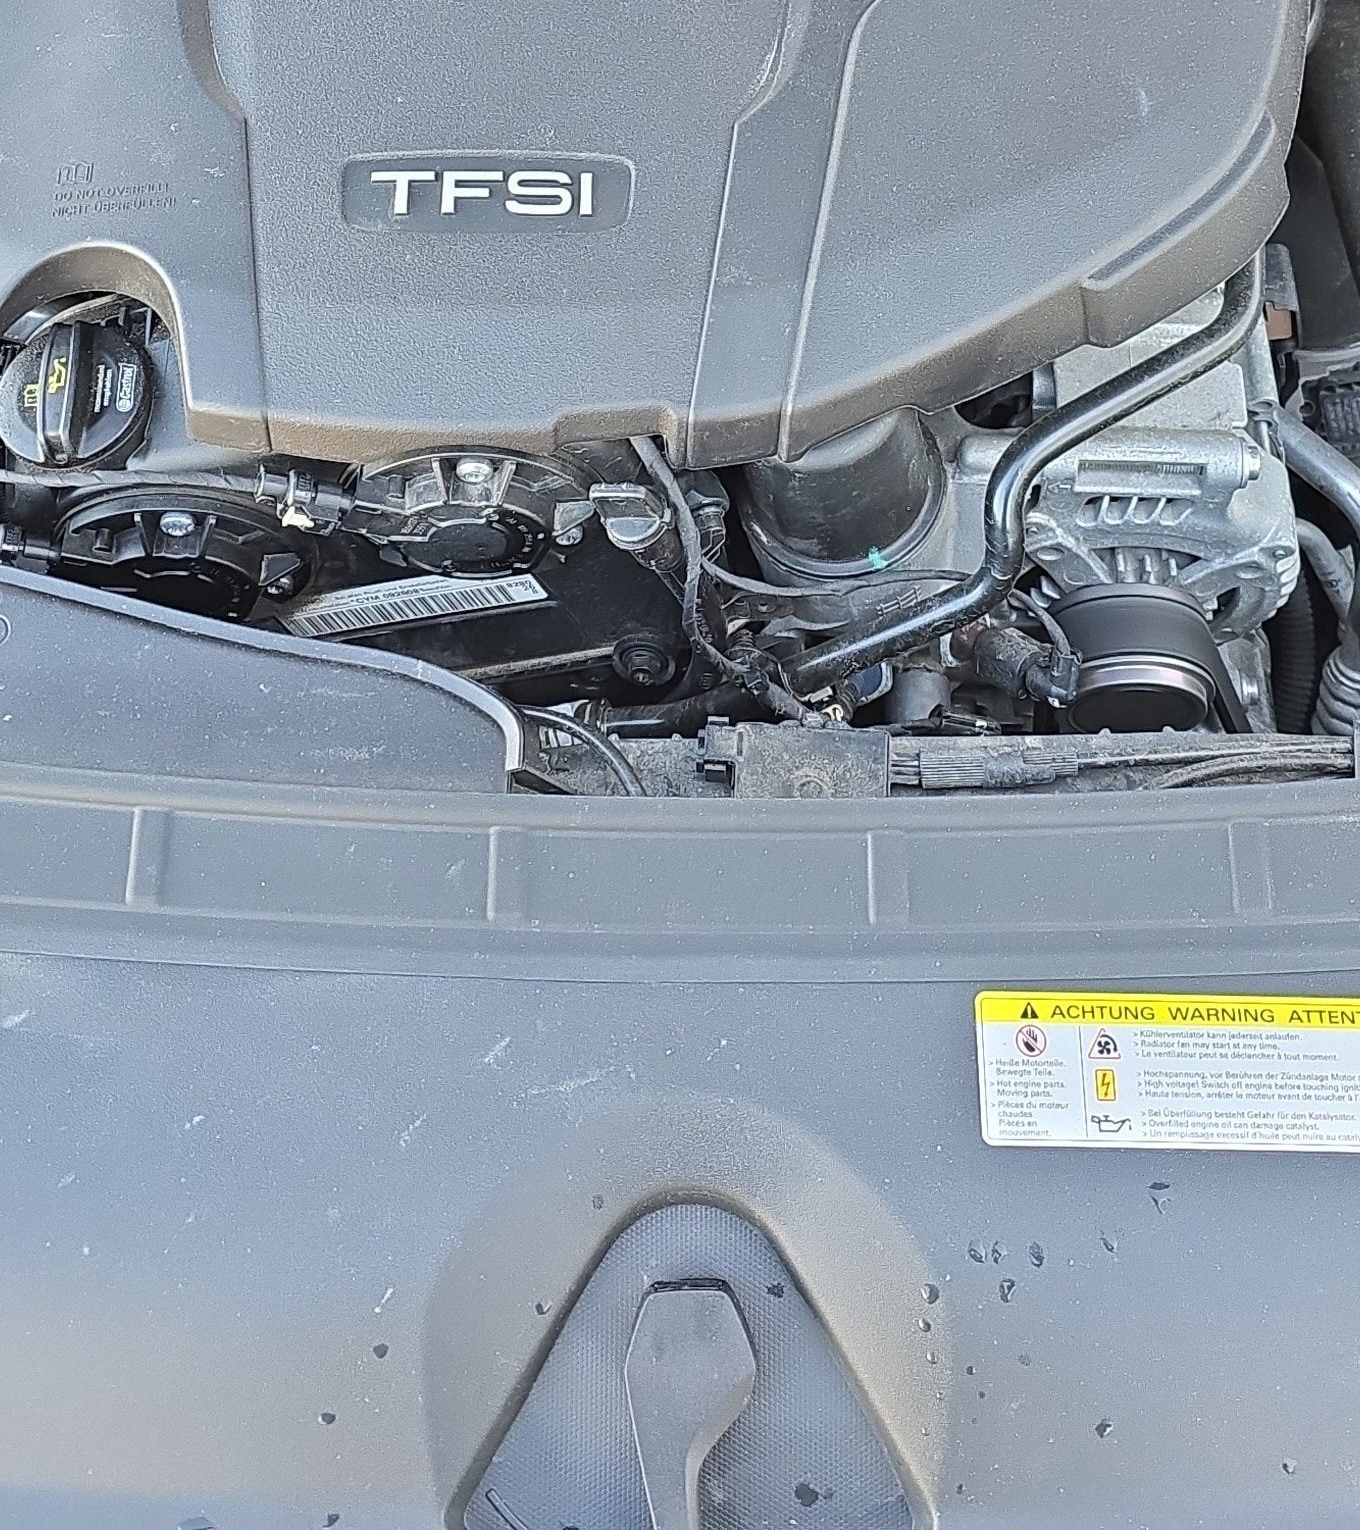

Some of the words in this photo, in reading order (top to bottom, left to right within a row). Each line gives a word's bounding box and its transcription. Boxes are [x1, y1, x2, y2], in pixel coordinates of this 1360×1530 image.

[54, 191, 73, 202] DO
[76, 187, 103, 200] NOT
[371, 170, 595, 216] TFSI
[120, 367, 133, 399] Castrol
[1050, 1004, 1155, 1021] ACHTUNG
[1167, 1007, 1275, 1023] WARNING
[1206, 1031, 1226, 1039] kann
[1140, 1040, 1175, 1048] Radiator
[1177, 1040, 1190, 1048] fan
[1192, 1042, 1209, 1050] may
[1242, 1043, 1257, 1051] any
[1153, 1050, 1197, 1058] ventilateur
[1199, 1051, 1218, 1061] peut
[1283, 1053, 1300, 1061] tout
[996, 1067, 1031, 1077] Bewegte
[1265, 1072, 1279, 1080] der
[1331, 1073, 1356, 1081] Motor
[1013, 1080, 1042, 1089] engine
[1043, 1081, 1067, 1089] parts.
[1144, 1080, 1163, 1089] High
[1201, 1080, 1229, 1089] Switch
[1231, 1081, 1243, 1089] off
[1244, 1081, 1273, 1091] engine
[1274, 1082, 1301, 1090] before
[1303, 1083, 1339, 1093] touching
[996, 1089, 1028, 1098] Moving
[1245, 1091, 1275, 1100] moteur
[1301, 1093, 1312, 1101] de
[1314, 1093, 1345, 1101] toucher
[1026, 1101, 1037, 1109] du
[1147, 1109, 1161, 1117] Bei
[1214, 1110, 1245, 1119] besteht
[1246, 1111, 1275, 1119] Gefahr
[1277, 1111, 1289, 1120] für
[1291, 1111, 1307, 1120] den
[1191, 1120, 1219, 1129] engine
[1250, 1121, 1284, 1131] damage
[1150, 1129, 1162, 1137] Un
[1282, 1133, 1300, 1141] peut
